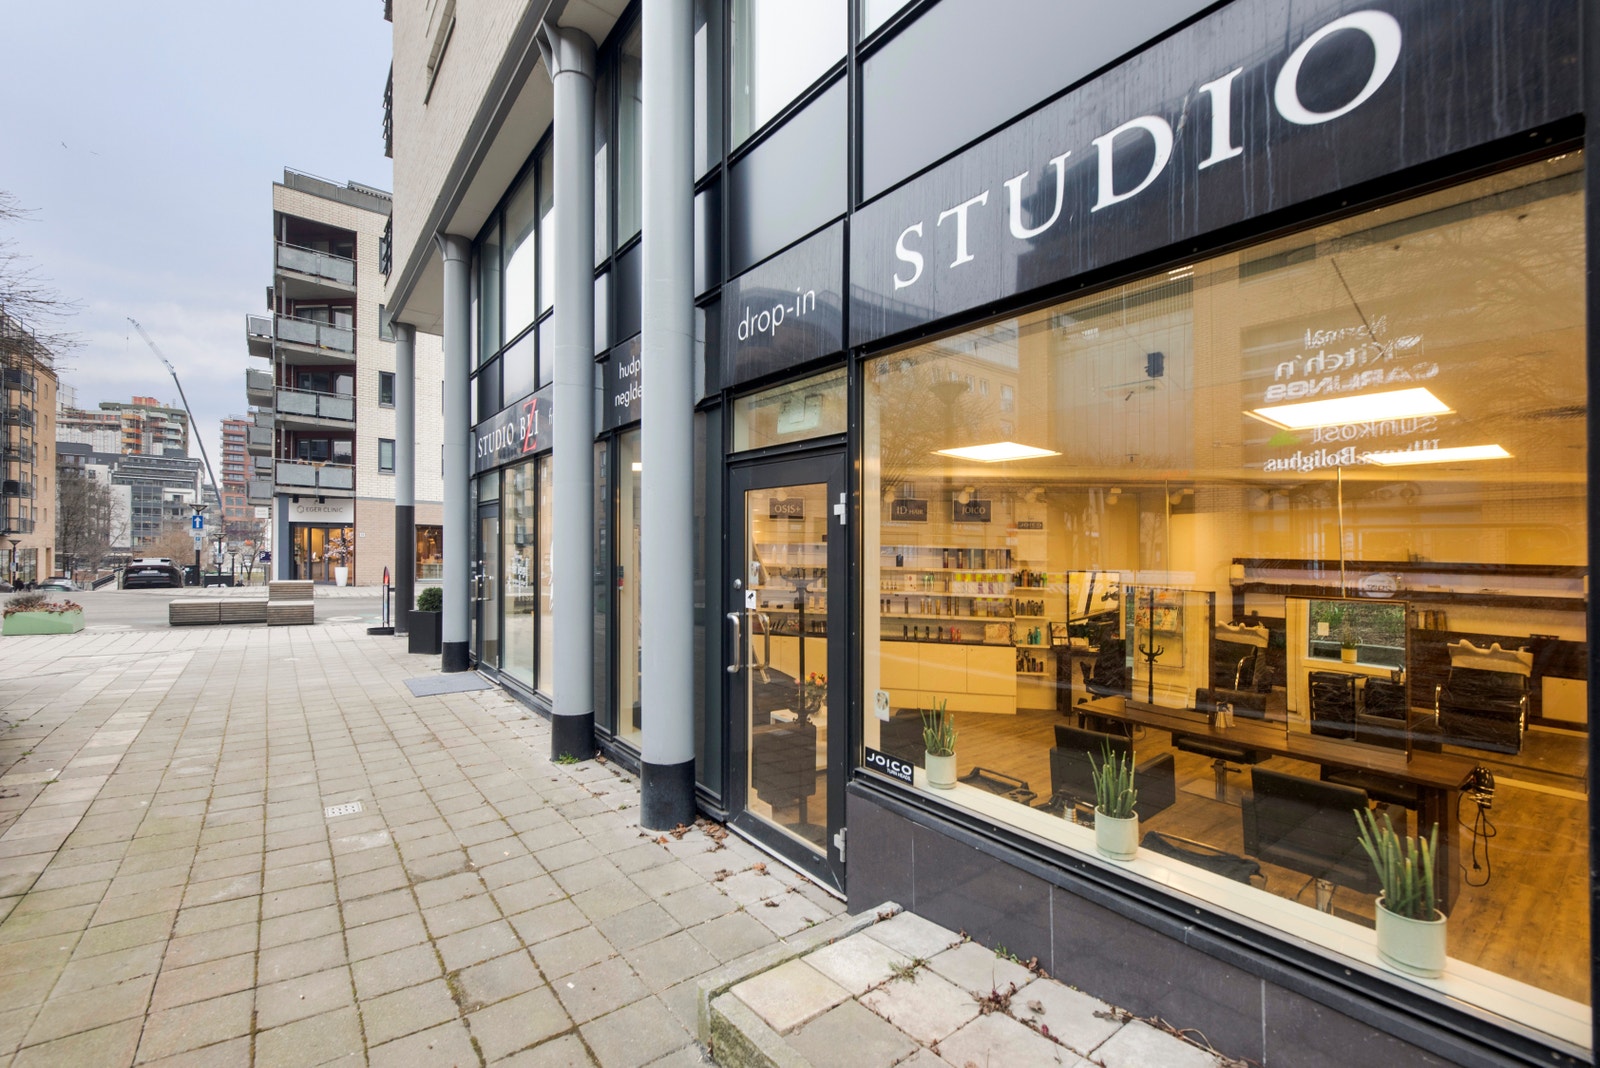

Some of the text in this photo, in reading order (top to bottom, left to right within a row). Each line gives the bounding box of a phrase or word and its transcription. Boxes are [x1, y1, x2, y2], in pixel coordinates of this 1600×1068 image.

[892, 9, 1402, 291] STUDIO
[738, 287, 815, 341] drop-in
[618, 355, 641, 379] hudp
[478, 422, 514, 458] STUDIO
[961, 506, 986, 515] JOICO
[866, 753, 912, 776] JOICO
